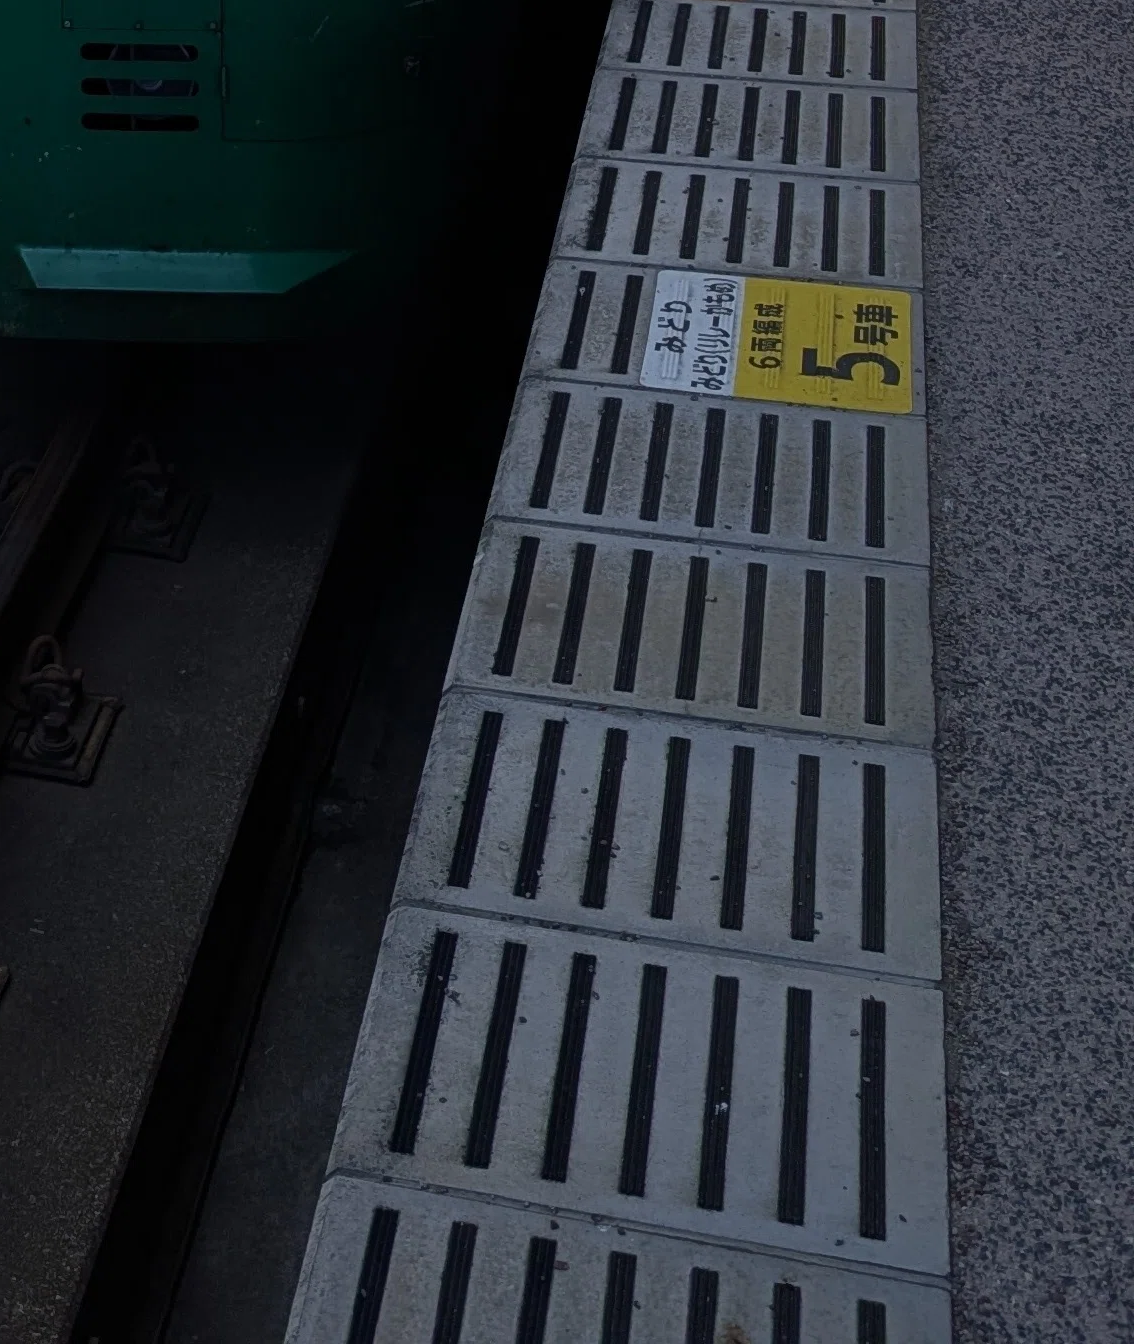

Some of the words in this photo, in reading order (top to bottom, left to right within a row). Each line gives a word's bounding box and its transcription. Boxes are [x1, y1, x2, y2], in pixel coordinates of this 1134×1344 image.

[654, 300, 693, 354] みどり
[748, 303, 784, 369] 6両編成
